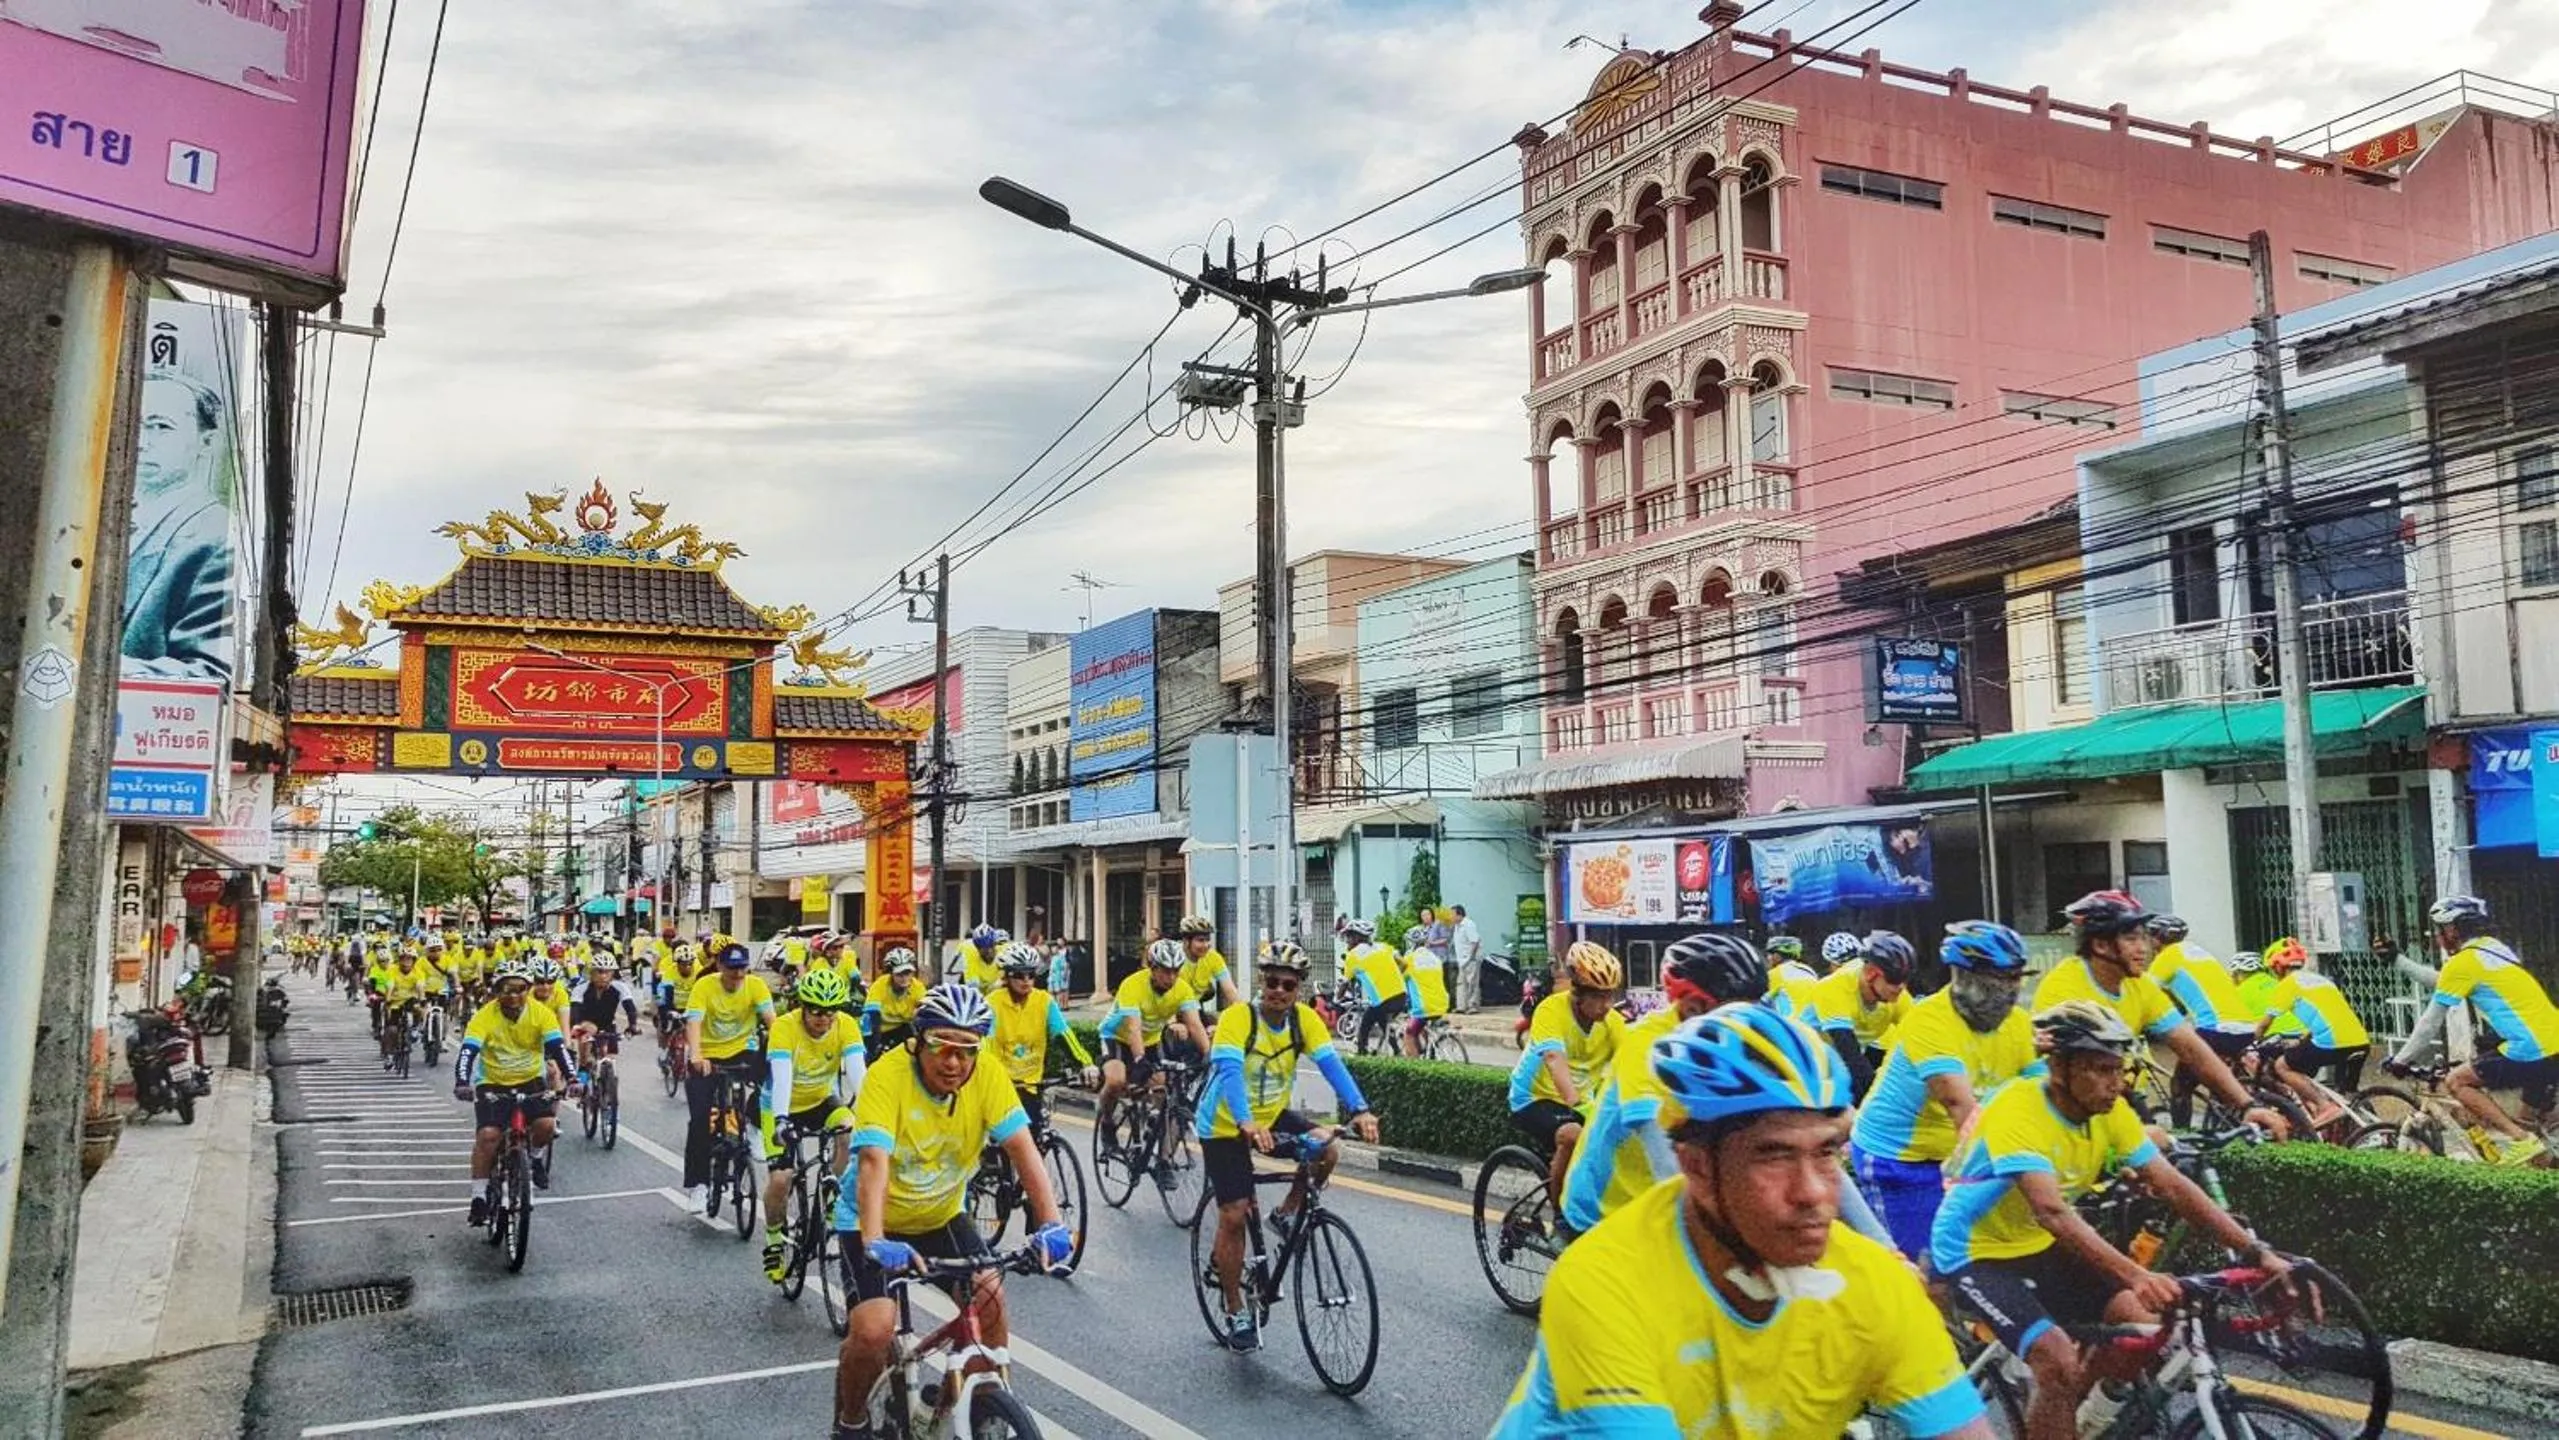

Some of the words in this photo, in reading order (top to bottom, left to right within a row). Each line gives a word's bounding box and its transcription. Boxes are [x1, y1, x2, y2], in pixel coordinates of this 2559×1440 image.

[32, 111, 132, 167] สาย
[182, 149, 200, 184] 1
[152, 706, 196, 721] หมอ
[2485, 749, 2532, 772] TU
